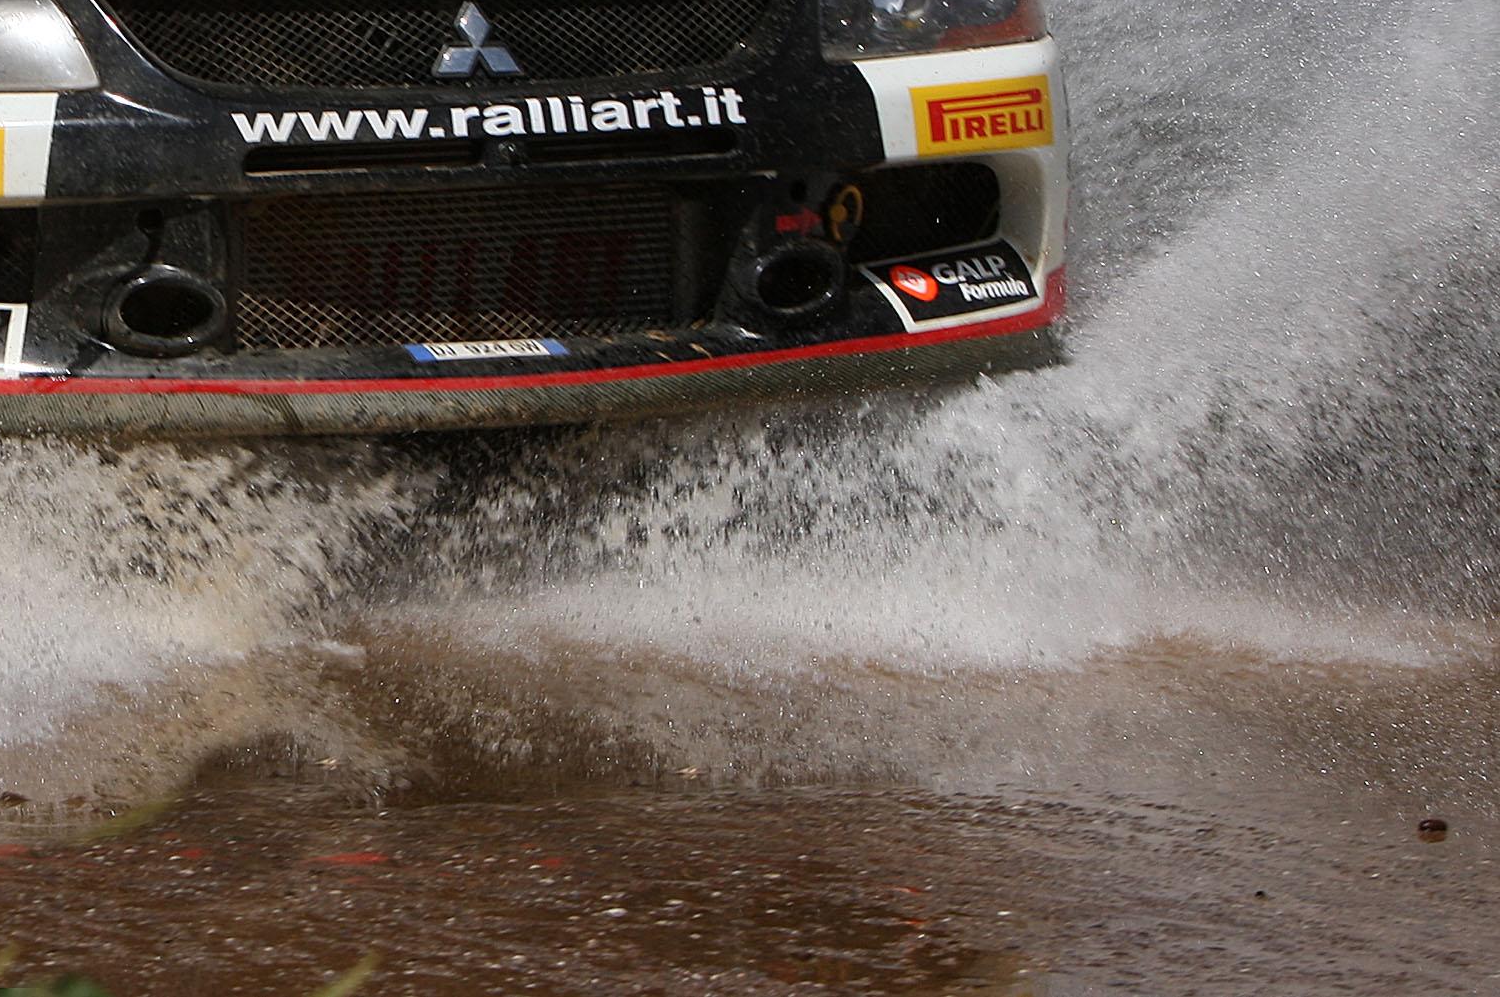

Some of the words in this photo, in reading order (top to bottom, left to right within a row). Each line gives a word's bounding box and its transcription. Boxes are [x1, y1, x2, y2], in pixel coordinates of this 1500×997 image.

[231, 87, 748, 144] www.ralliart.it
[927, 88, 1045, 143] PIRELLI
[931, 255, 1006, 284] GALP
